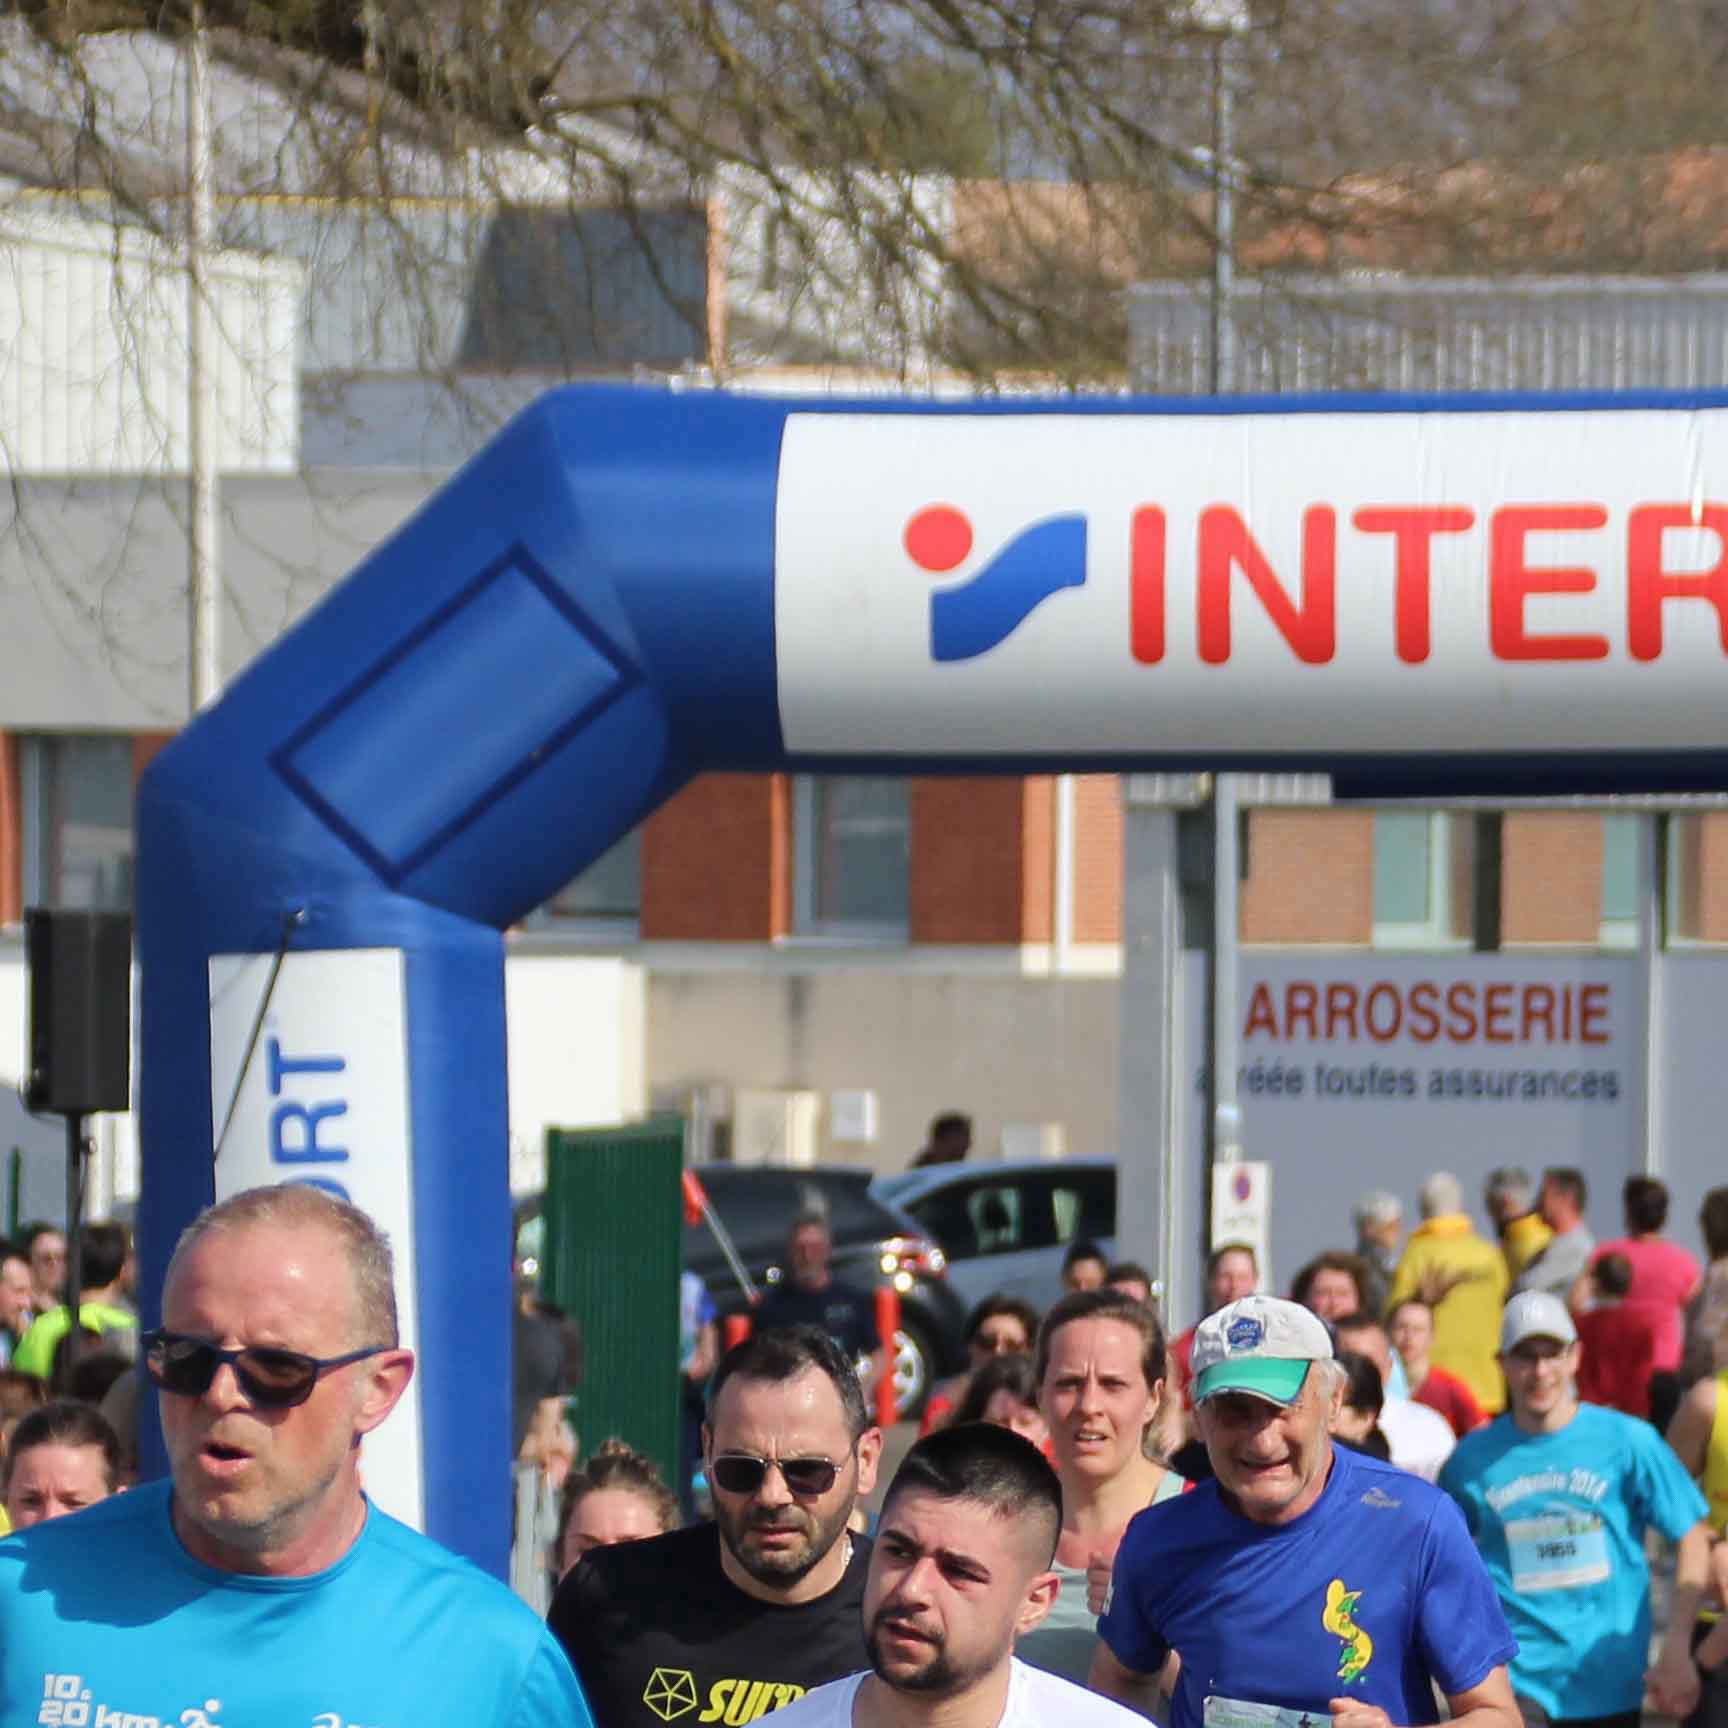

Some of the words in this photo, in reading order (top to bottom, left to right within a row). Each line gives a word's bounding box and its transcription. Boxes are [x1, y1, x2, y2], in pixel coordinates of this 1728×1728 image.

[1242, 982, 1613, 1044] ARROSSERIE
[1315, 1060, 1416, 1098] toutes
[1427, 1062, 1621, 1100] assurances
[44, 1673, 81, 1700] 10
[38, 1700, 90, 1727] 20
